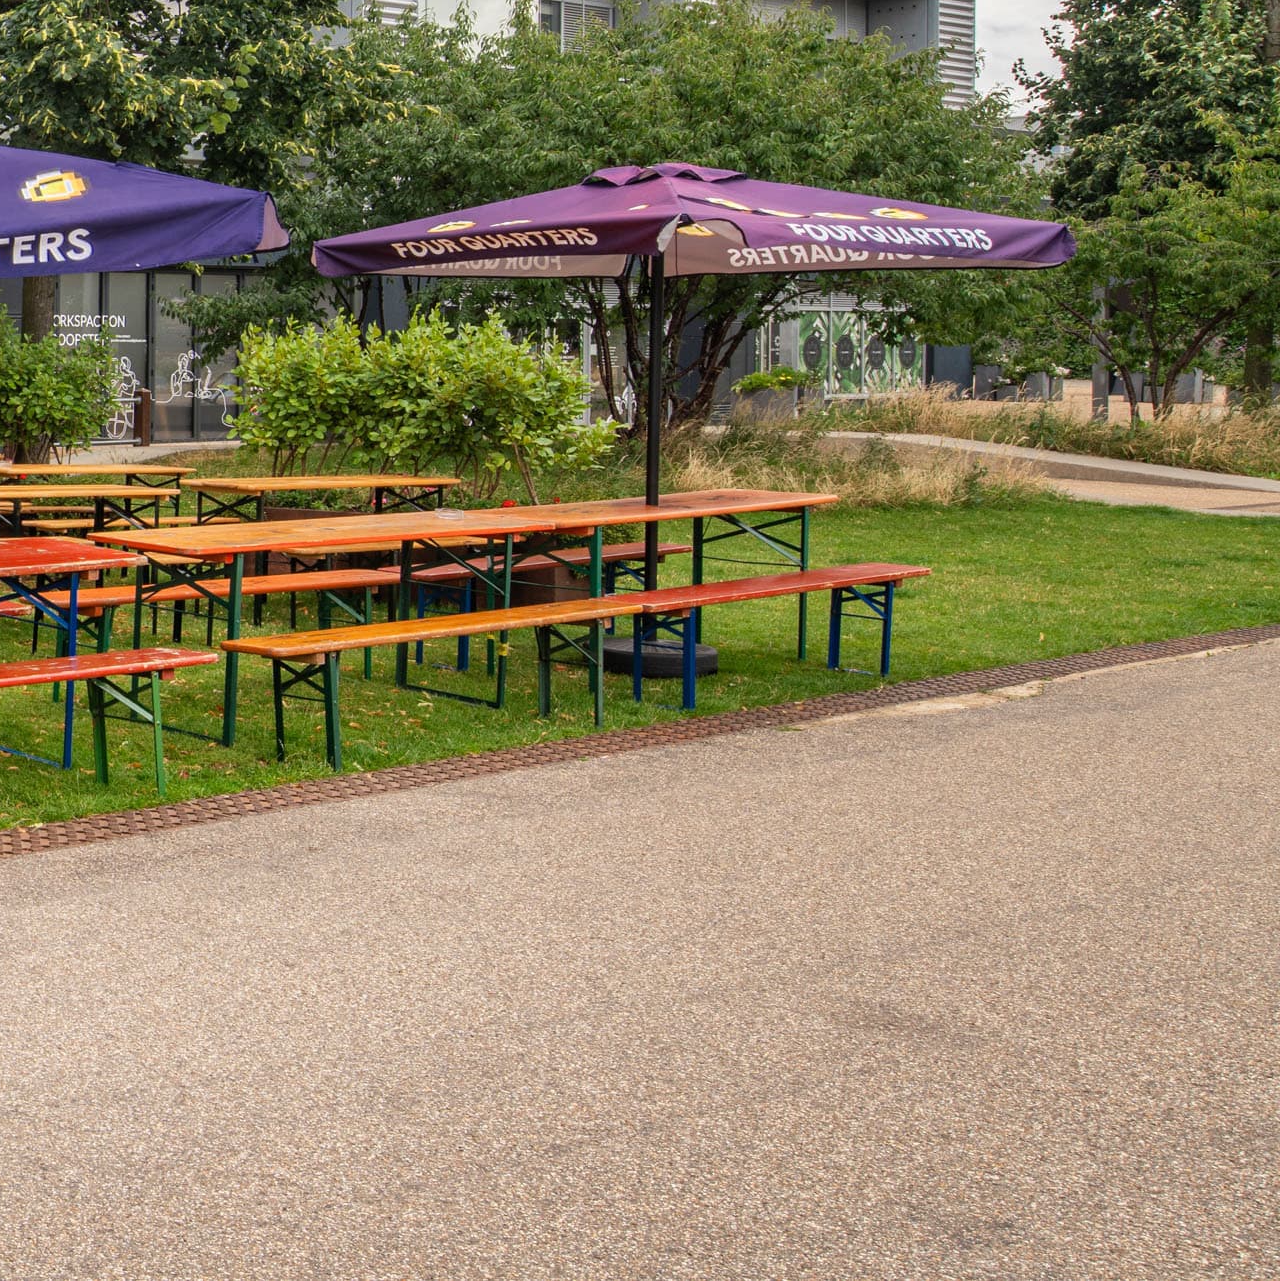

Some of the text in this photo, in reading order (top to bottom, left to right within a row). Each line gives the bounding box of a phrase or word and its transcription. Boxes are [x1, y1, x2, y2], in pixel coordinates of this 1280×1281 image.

[392, 227, 598, 258] FOUR QUARTERS
[786, 222, 993, 251] FOUR QUARTERS
[109, 314, 126, 327] ON
